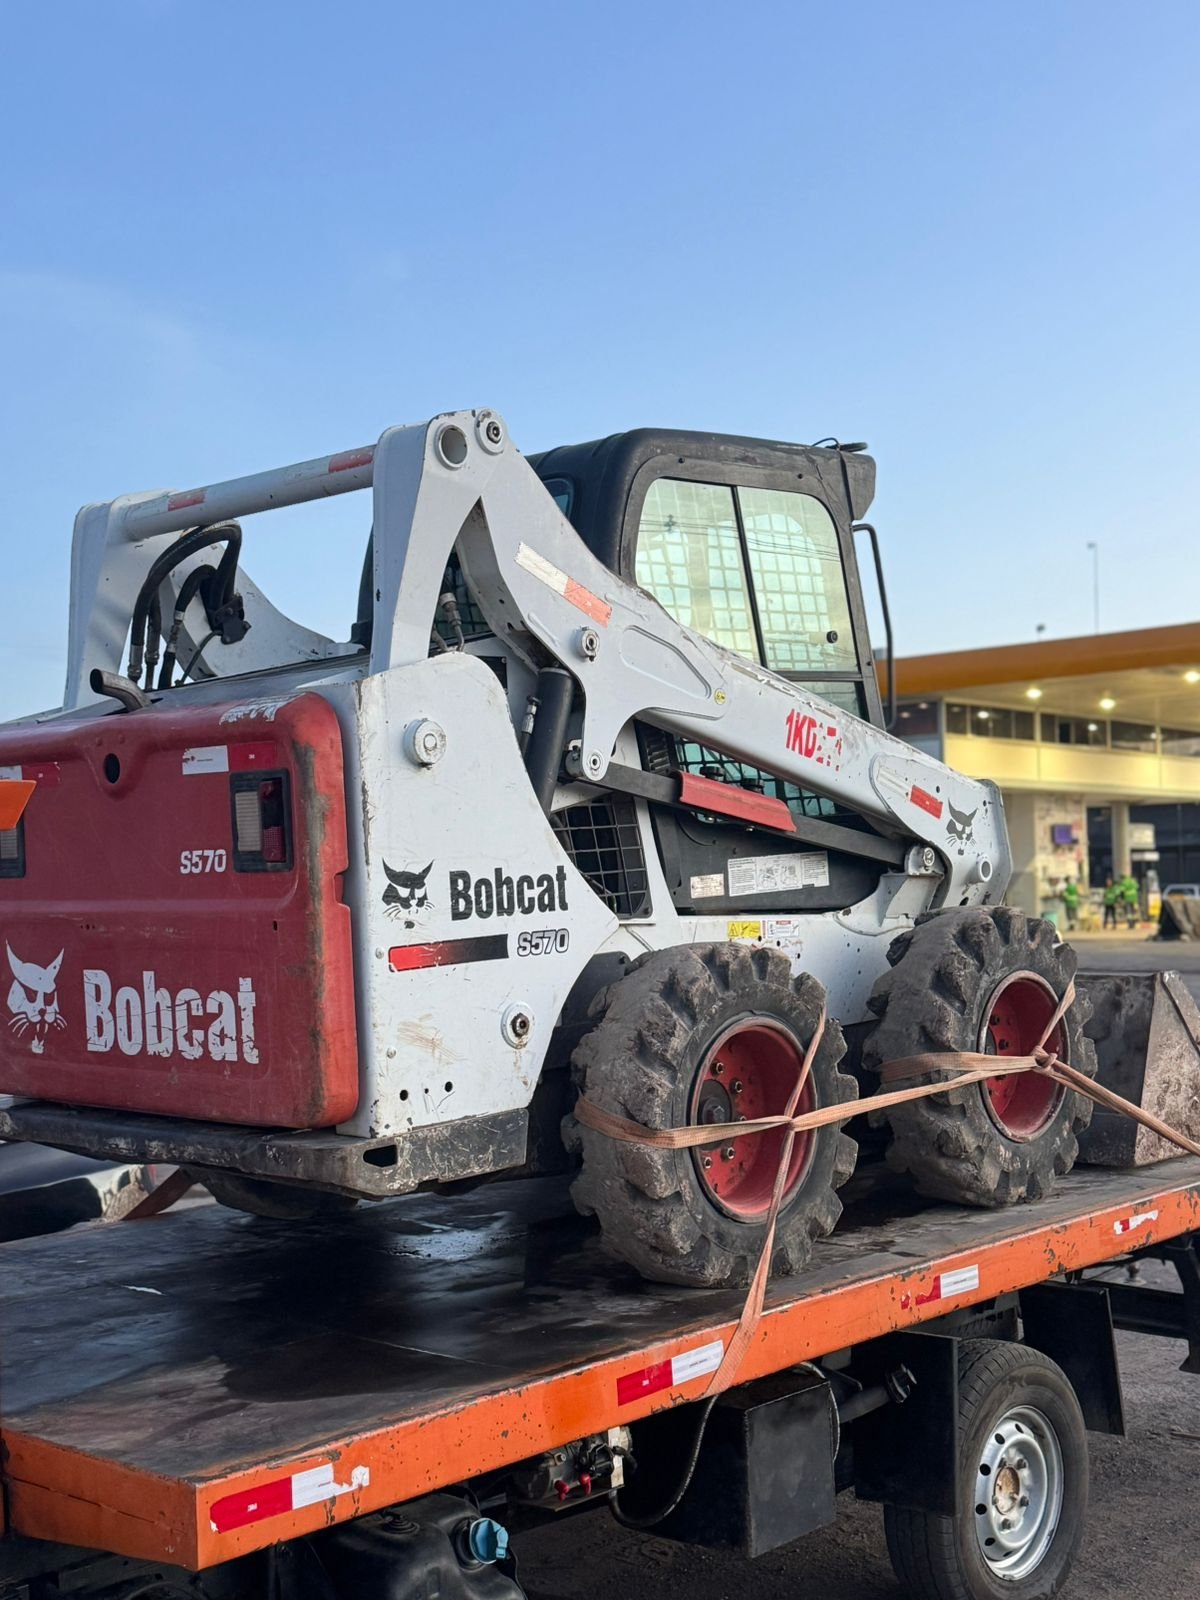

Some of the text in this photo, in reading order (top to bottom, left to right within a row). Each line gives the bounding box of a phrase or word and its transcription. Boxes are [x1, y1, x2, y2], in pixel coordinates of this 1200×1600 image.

[180, 848, 227, 874] S570
[449, 865, 569, 921] Bobcat
[517, 928, 570, 957] S570
[83, 969, 260, 1065] Bobcat
